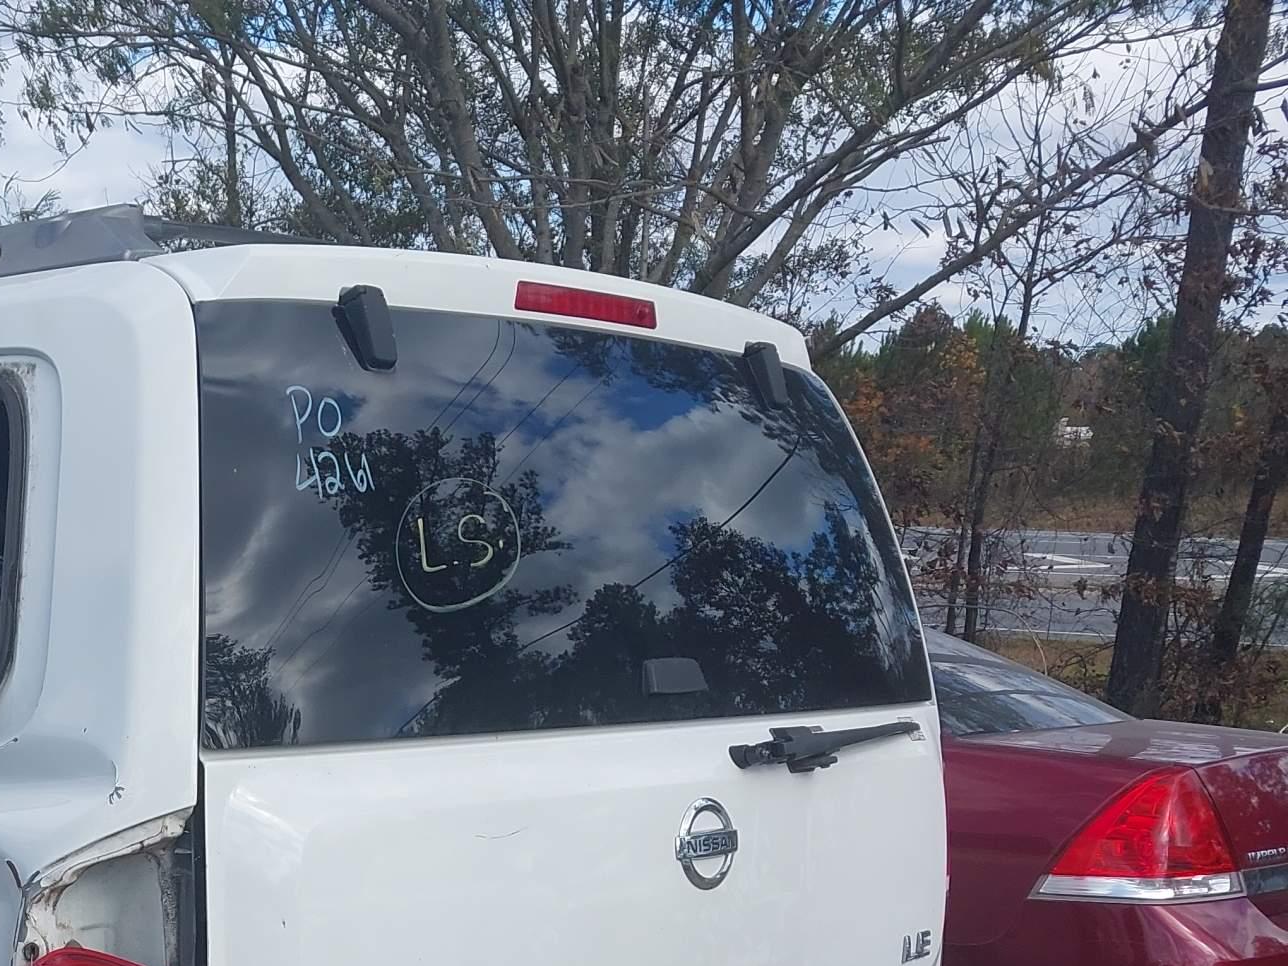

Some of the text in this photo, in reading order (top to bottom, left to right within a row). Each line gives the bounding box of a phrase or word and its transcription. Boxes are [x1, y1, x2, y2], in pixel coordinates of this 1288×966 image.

[286, 385, 342, 444] PO
[295, 447, 377, 500] 4261
[686, 835, 738, 854] NISSAN
[901, 929, 932, 965] LE
